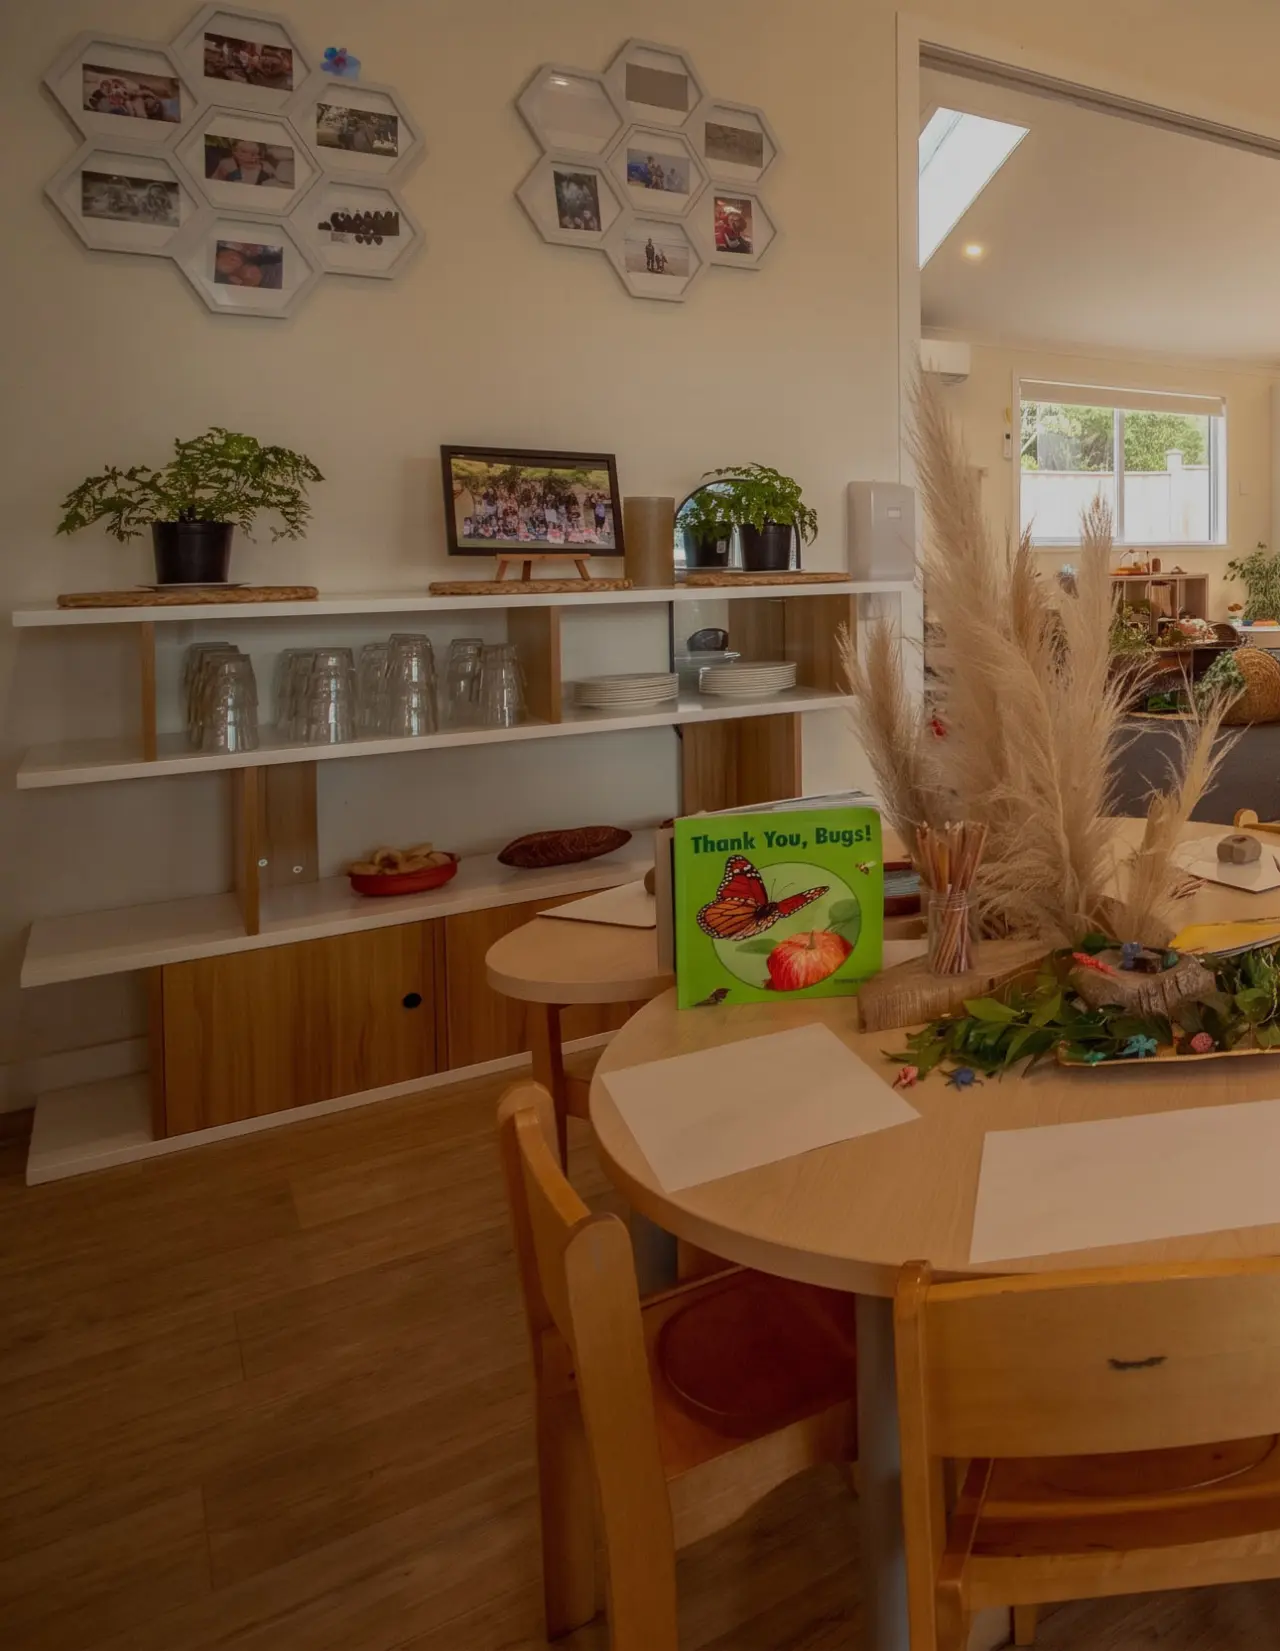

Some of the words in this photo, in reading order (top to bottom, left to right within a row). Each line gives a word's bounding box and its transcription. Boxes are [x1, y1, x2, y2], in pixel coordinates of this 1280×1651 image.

[691, 832, 756, 854] Thank
[763, 829, 808, 850] You,
[815, 824, 872, 848] Bugs!
